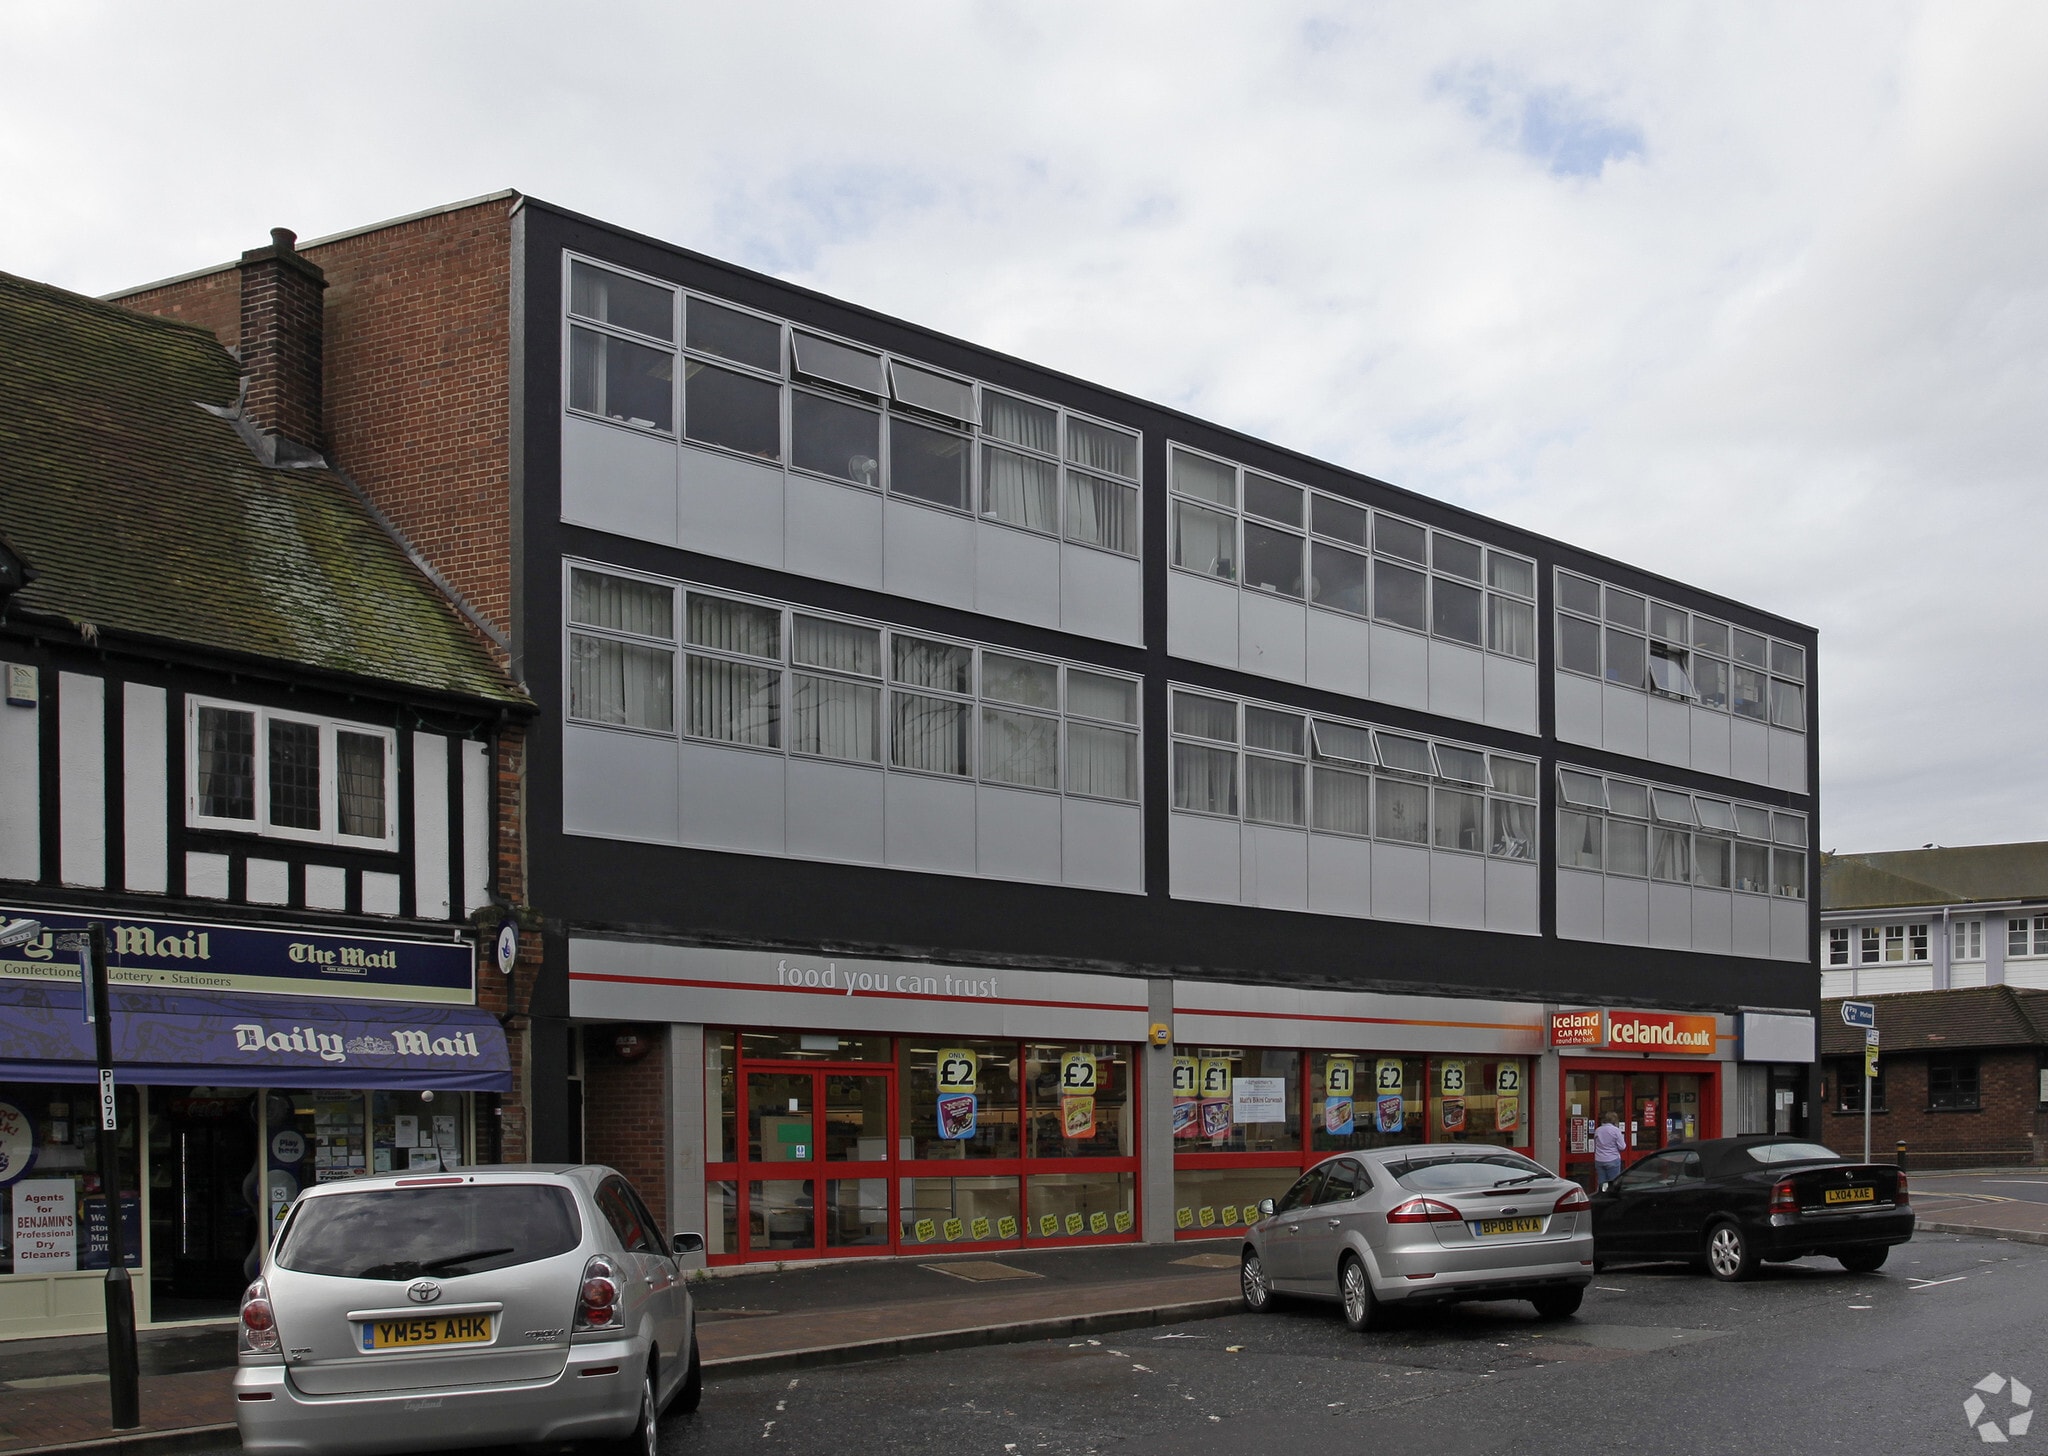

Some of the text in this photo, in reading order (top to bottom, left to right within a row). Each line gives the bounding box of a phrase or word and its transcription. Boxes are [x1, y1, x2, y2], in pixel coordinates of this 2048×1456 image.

[112, 925, 211, 960] Mail
[288, 942, 397, 969] The Mail
[4, 963, 232, 987] Confectione Lottery Stationers
[777, 959, 998, 998] food you can trust
[1552, 1014, 1599, 1028] Iceland
[1574, 1028, 1594, 1036] PARK
[1608, 1018, 1710, 1046] Iceland.co.uk
[232, 1024, 480, 1063] Daily Mail
[940, 1060, 974, 1085] £2
[1064, 1063, 1094, 1087] £2
[1173, 1066, 1194, 1089] £1
[1205, 1068, 1227, 1090] £1
[1330, 1068, 1349, 1090] £1
[1379, 1067, 1400, 1088] £2
[1444, 1069, 1463, 1089] £3
[1498, 1070, 1518, 1090] £2
[102, 1070, 114, 1128] P1079
[280, 1139, 298, 1147] Play
[25, 1194, 64, 1204] Agents
[1829, 1188, 1870, 1200] LX04 XAE
[18, 1216, 73, 1228] BENJAMIN'S
[1483, 1218, 1539, 1233] BP08 KVA
[16, 1230, 73, 1238] Professional
[21, 1250, 70, 1259] Cleaners
[36, 1242, 55, 1250] Dry
[380, 1318, 486, 1342] YM55 AHK
